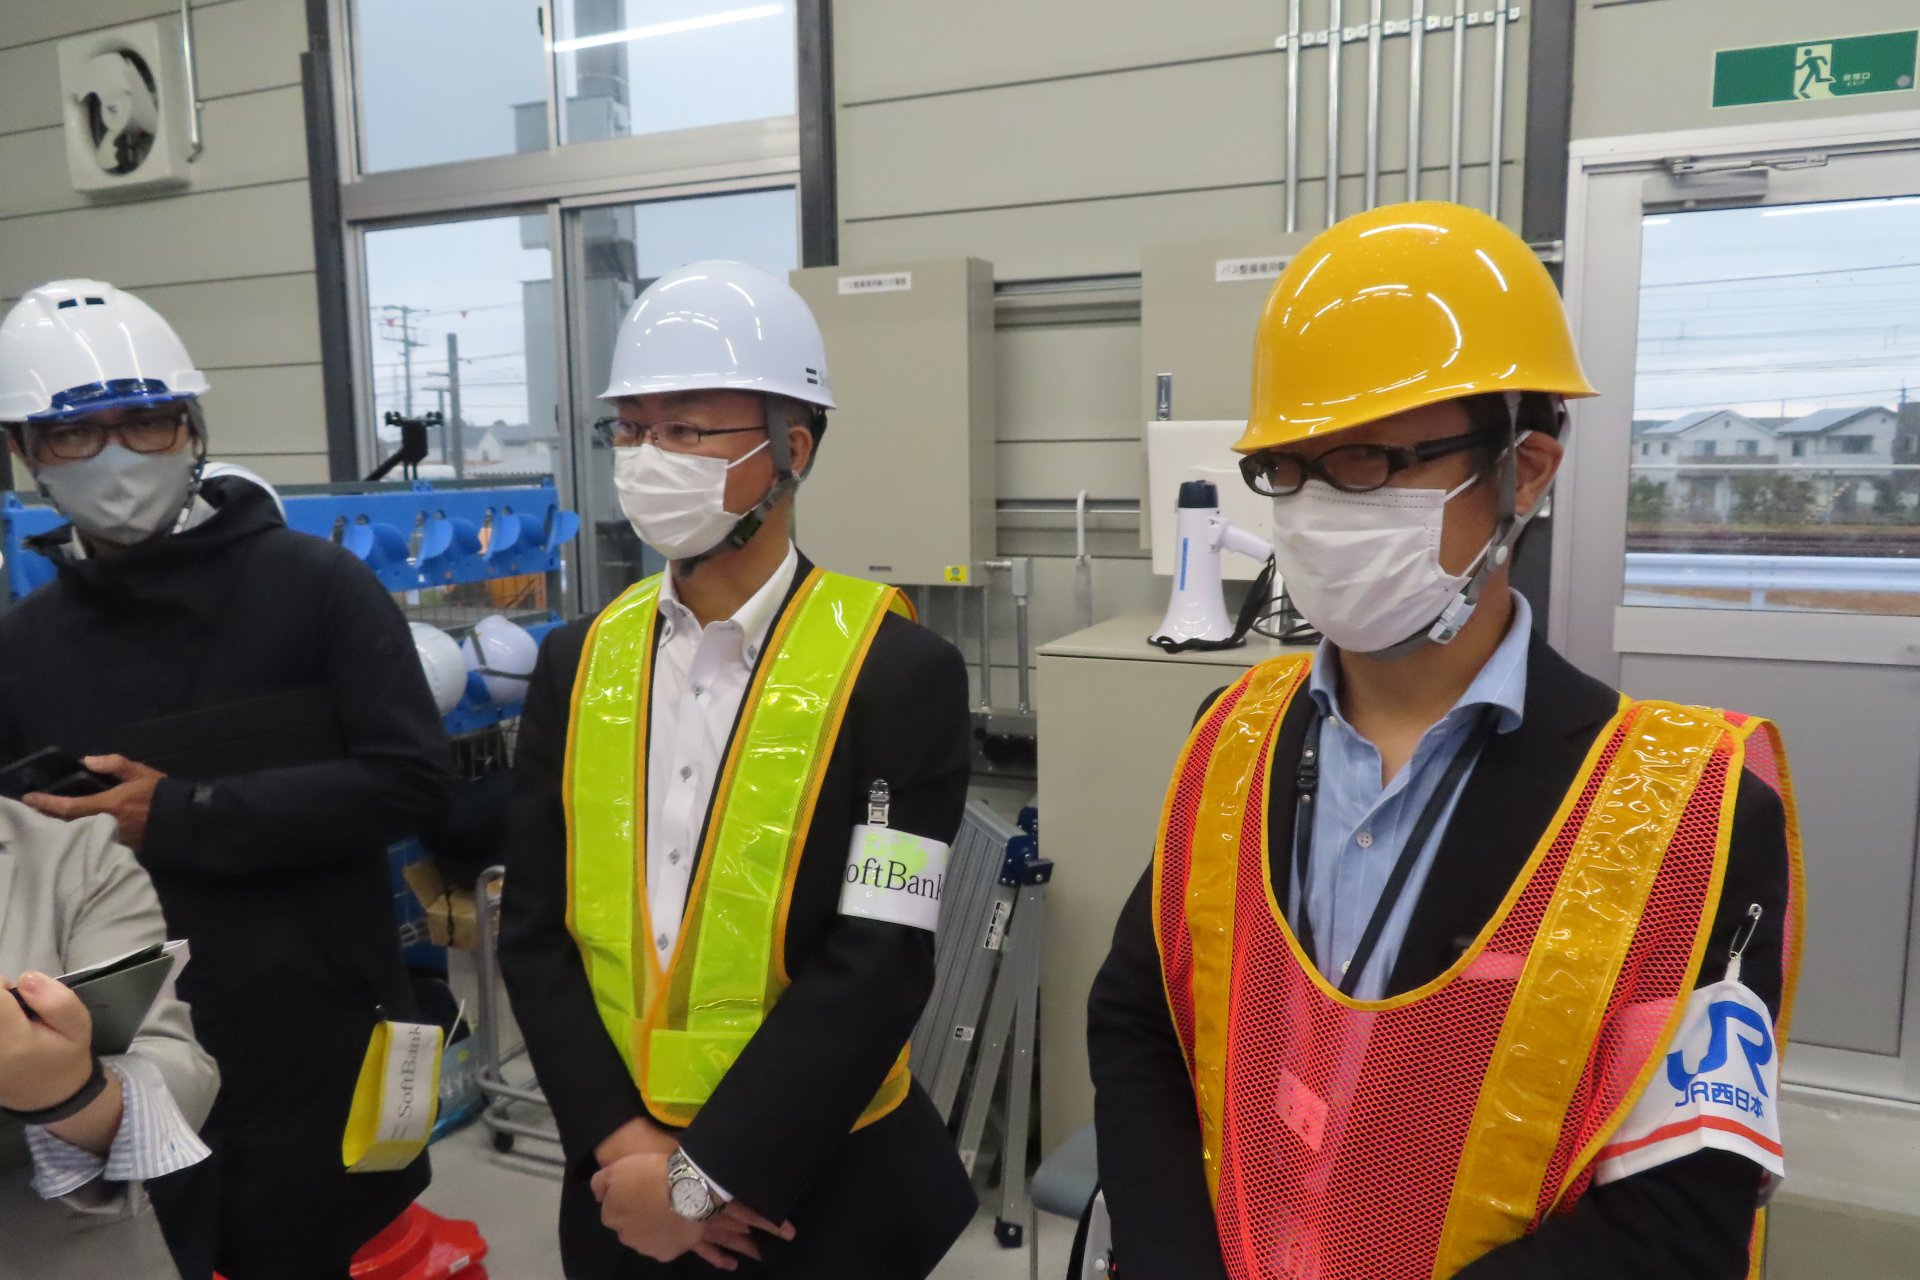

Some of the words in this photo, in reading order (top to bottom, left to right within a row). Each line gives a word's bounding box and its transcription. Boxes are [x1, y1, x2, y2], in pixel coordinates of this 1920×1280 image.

[844, 857, 943, 901] oftBank
[398, 1025, 421, 1119] SoftBank
[1666, 1000, 1773, 1099] JR
[1674, 1081, 1764, 1119] JR西日本
